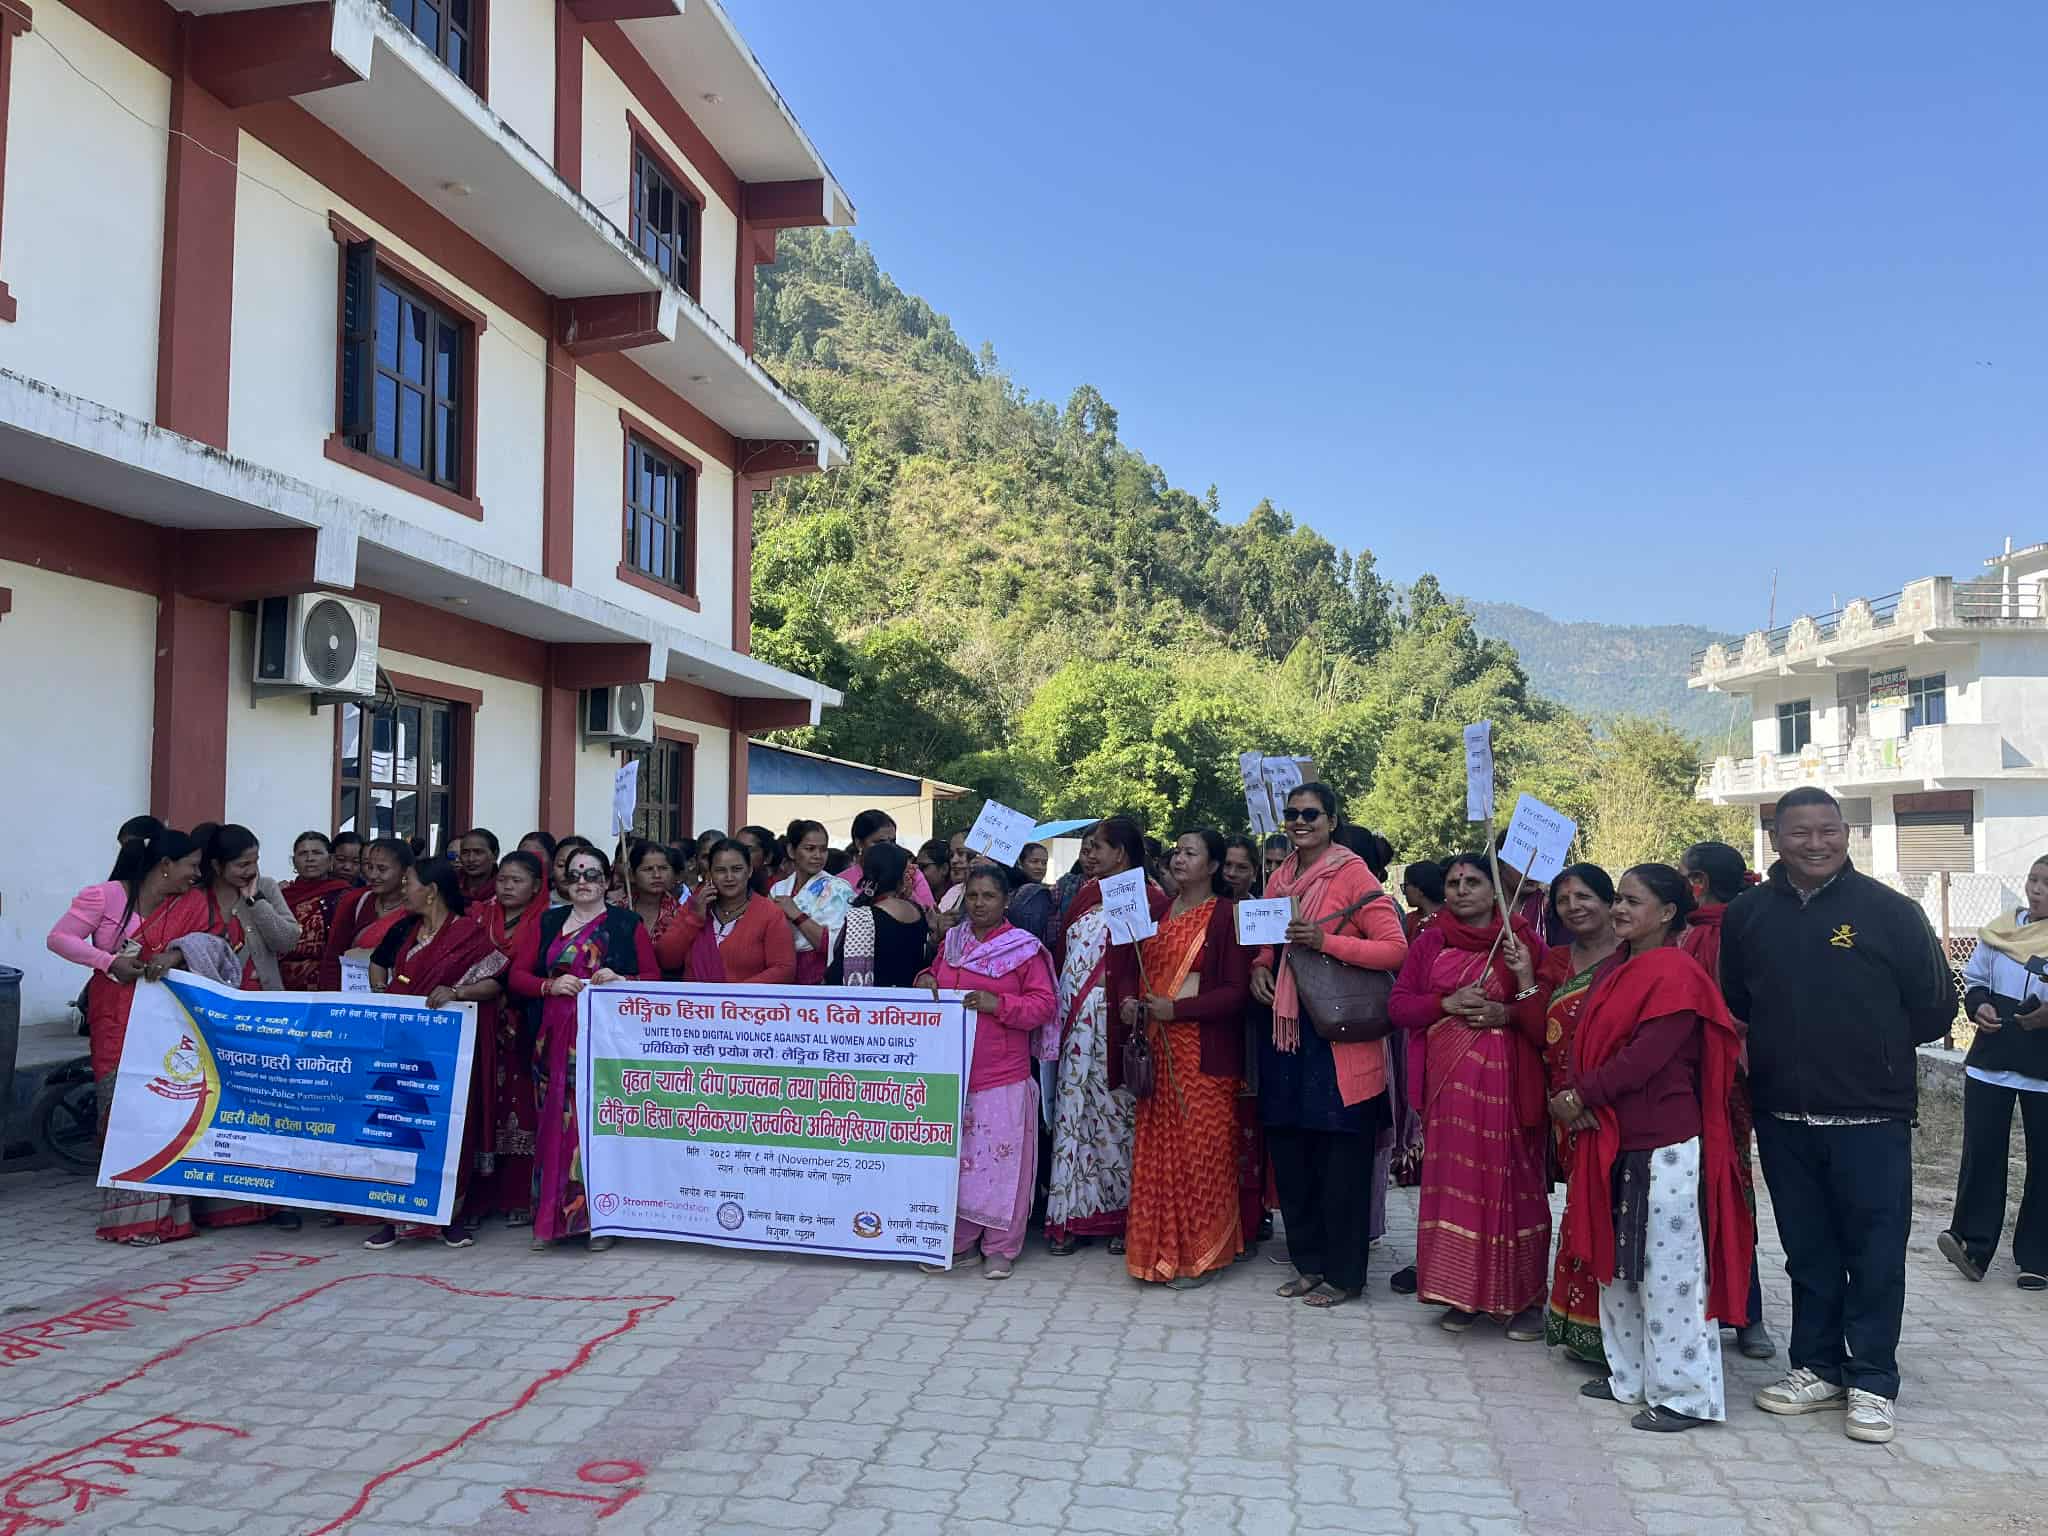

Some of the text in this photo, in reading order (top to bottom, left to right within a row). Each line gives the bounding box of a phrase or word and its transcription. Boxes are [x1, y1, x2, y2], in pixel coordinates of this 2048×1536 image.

[618, 996, 673, 1023] लैङ्गिक
[677, 999, 715, 1019] हिंसा
[797, 1007, 819, 1024] १६
[826, 1003, 861, 1025] दिने
[867, 1005, 942, 1027] अभियान
[672, 1028, 681, 1038] TO
[683, 1029, 700, 1039] END
[703, 1030, 734, 1041] DIGITAL
[736, 1031, 772, 1042] VIOLNCE
[774, 1032, 811, 1044] AGAINST
[813, 1034, 828, 1045] ALL
[830, 1035, 864, 1046] WOMEN
[867, 1036, 886, 1047] AND
[216, 1047, 352, 1074] समुदाय प्रहरी साझेदारी
[694, 1043, 714, 1056] सही
[718, 1045, 749, 1058] प्रयोग
[823, 1048, 849, 1063] हिंसा
[854, 1052, 889, 1064] अन्त्य
[700, 1066, 725, 1094] दीप
[787, 1077, 814, 1100] तथा
[818, 1072, 856, 1103] प्रविधि
[860, 1077, 902, 1105] मार्फत
[904, 1078, 927, 1111] हुने
[220, 1109, 245, 1125] प्रहरी
[598, 1096, 641, 1135] लैङ्गिक
[644, 1099, 673, 1129] हिंसा
[889, 1115, 953, 1145] कार्यक्रम
[778, 1153, 836, 1168] (November
[855, 1158, 886, 1172] 2025)
[184, 1168, 204, 1181] फोन
